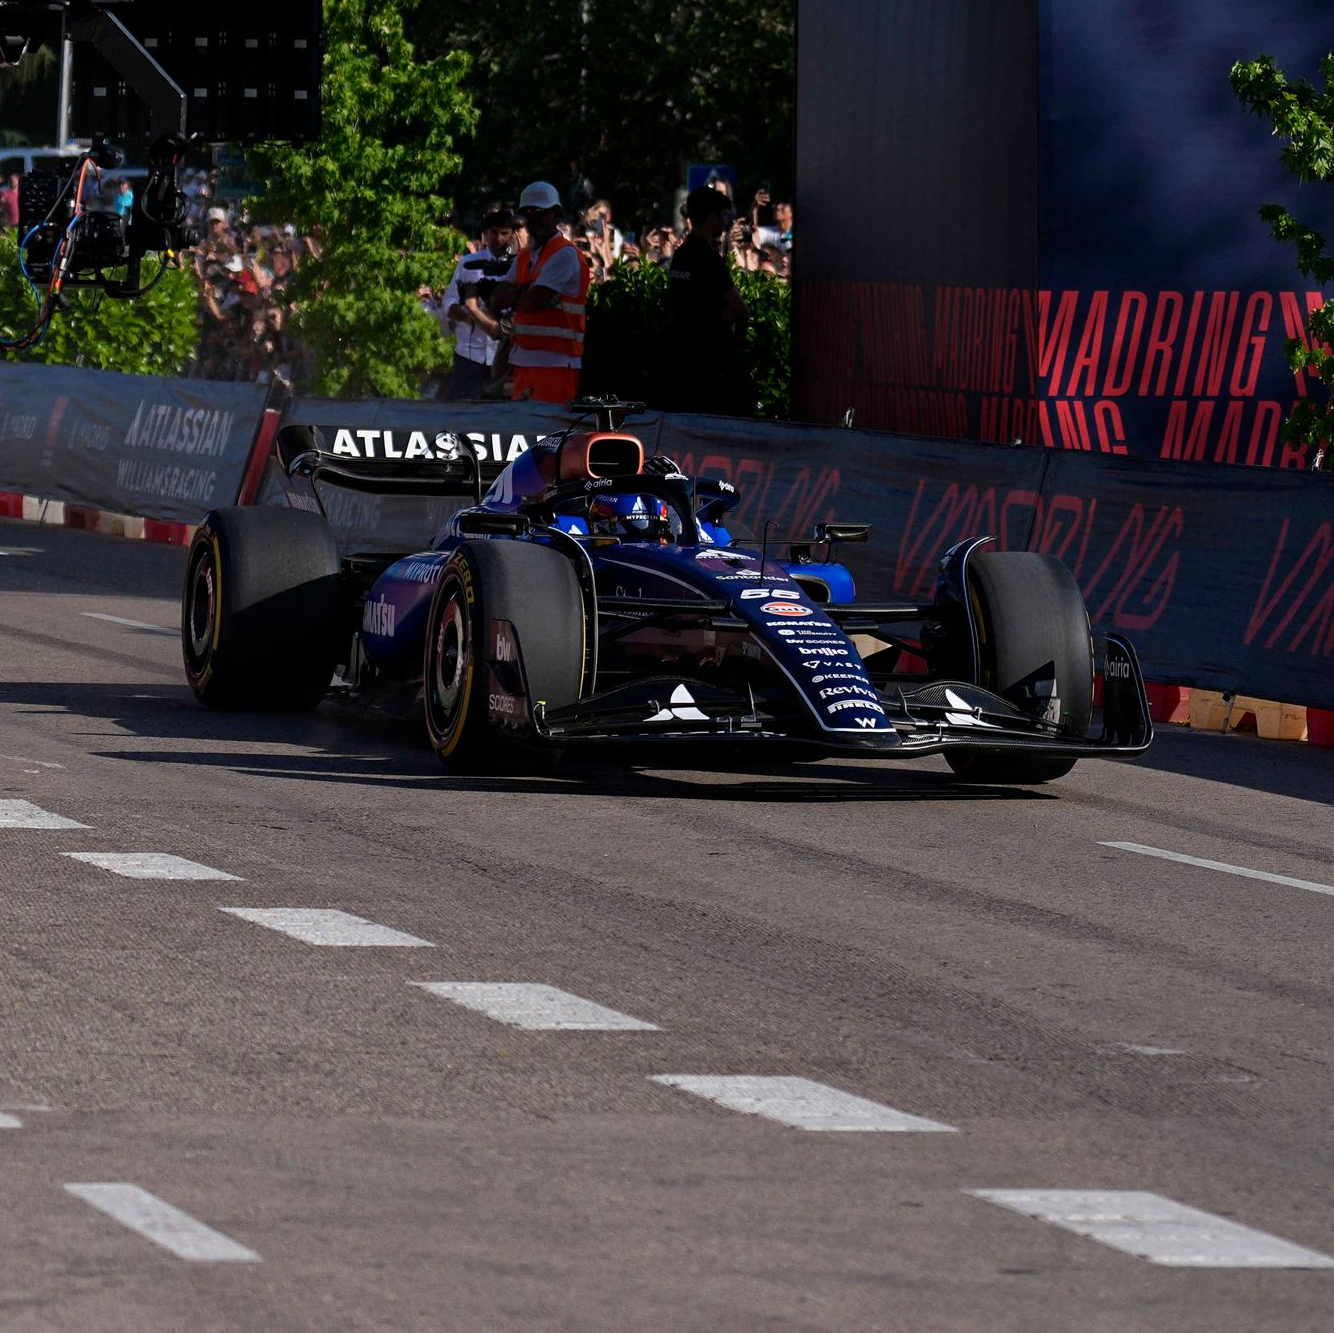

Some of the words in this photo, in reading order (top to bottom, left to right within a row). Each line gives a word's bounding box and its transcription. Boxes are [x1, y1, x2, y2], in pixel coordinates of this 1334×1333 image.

[137, 405, 235, 457] ATLASSIAN
[332, 428, 549, 462] ATLASSIA
[168, 467, 217, 502] RACING
[403, 561, 445, 585] MYPROT
[455, 552, 476, 604] ZERO
[740, 588, 801, 600] 55
[798, 647, 849, 657] brillio
[823, 661, 862, 671] VAST
[1109, 655, 1130, 679] airia
[824, 673, 870, 685] KEEPER
[488, 693, 515, 714] SCORES
